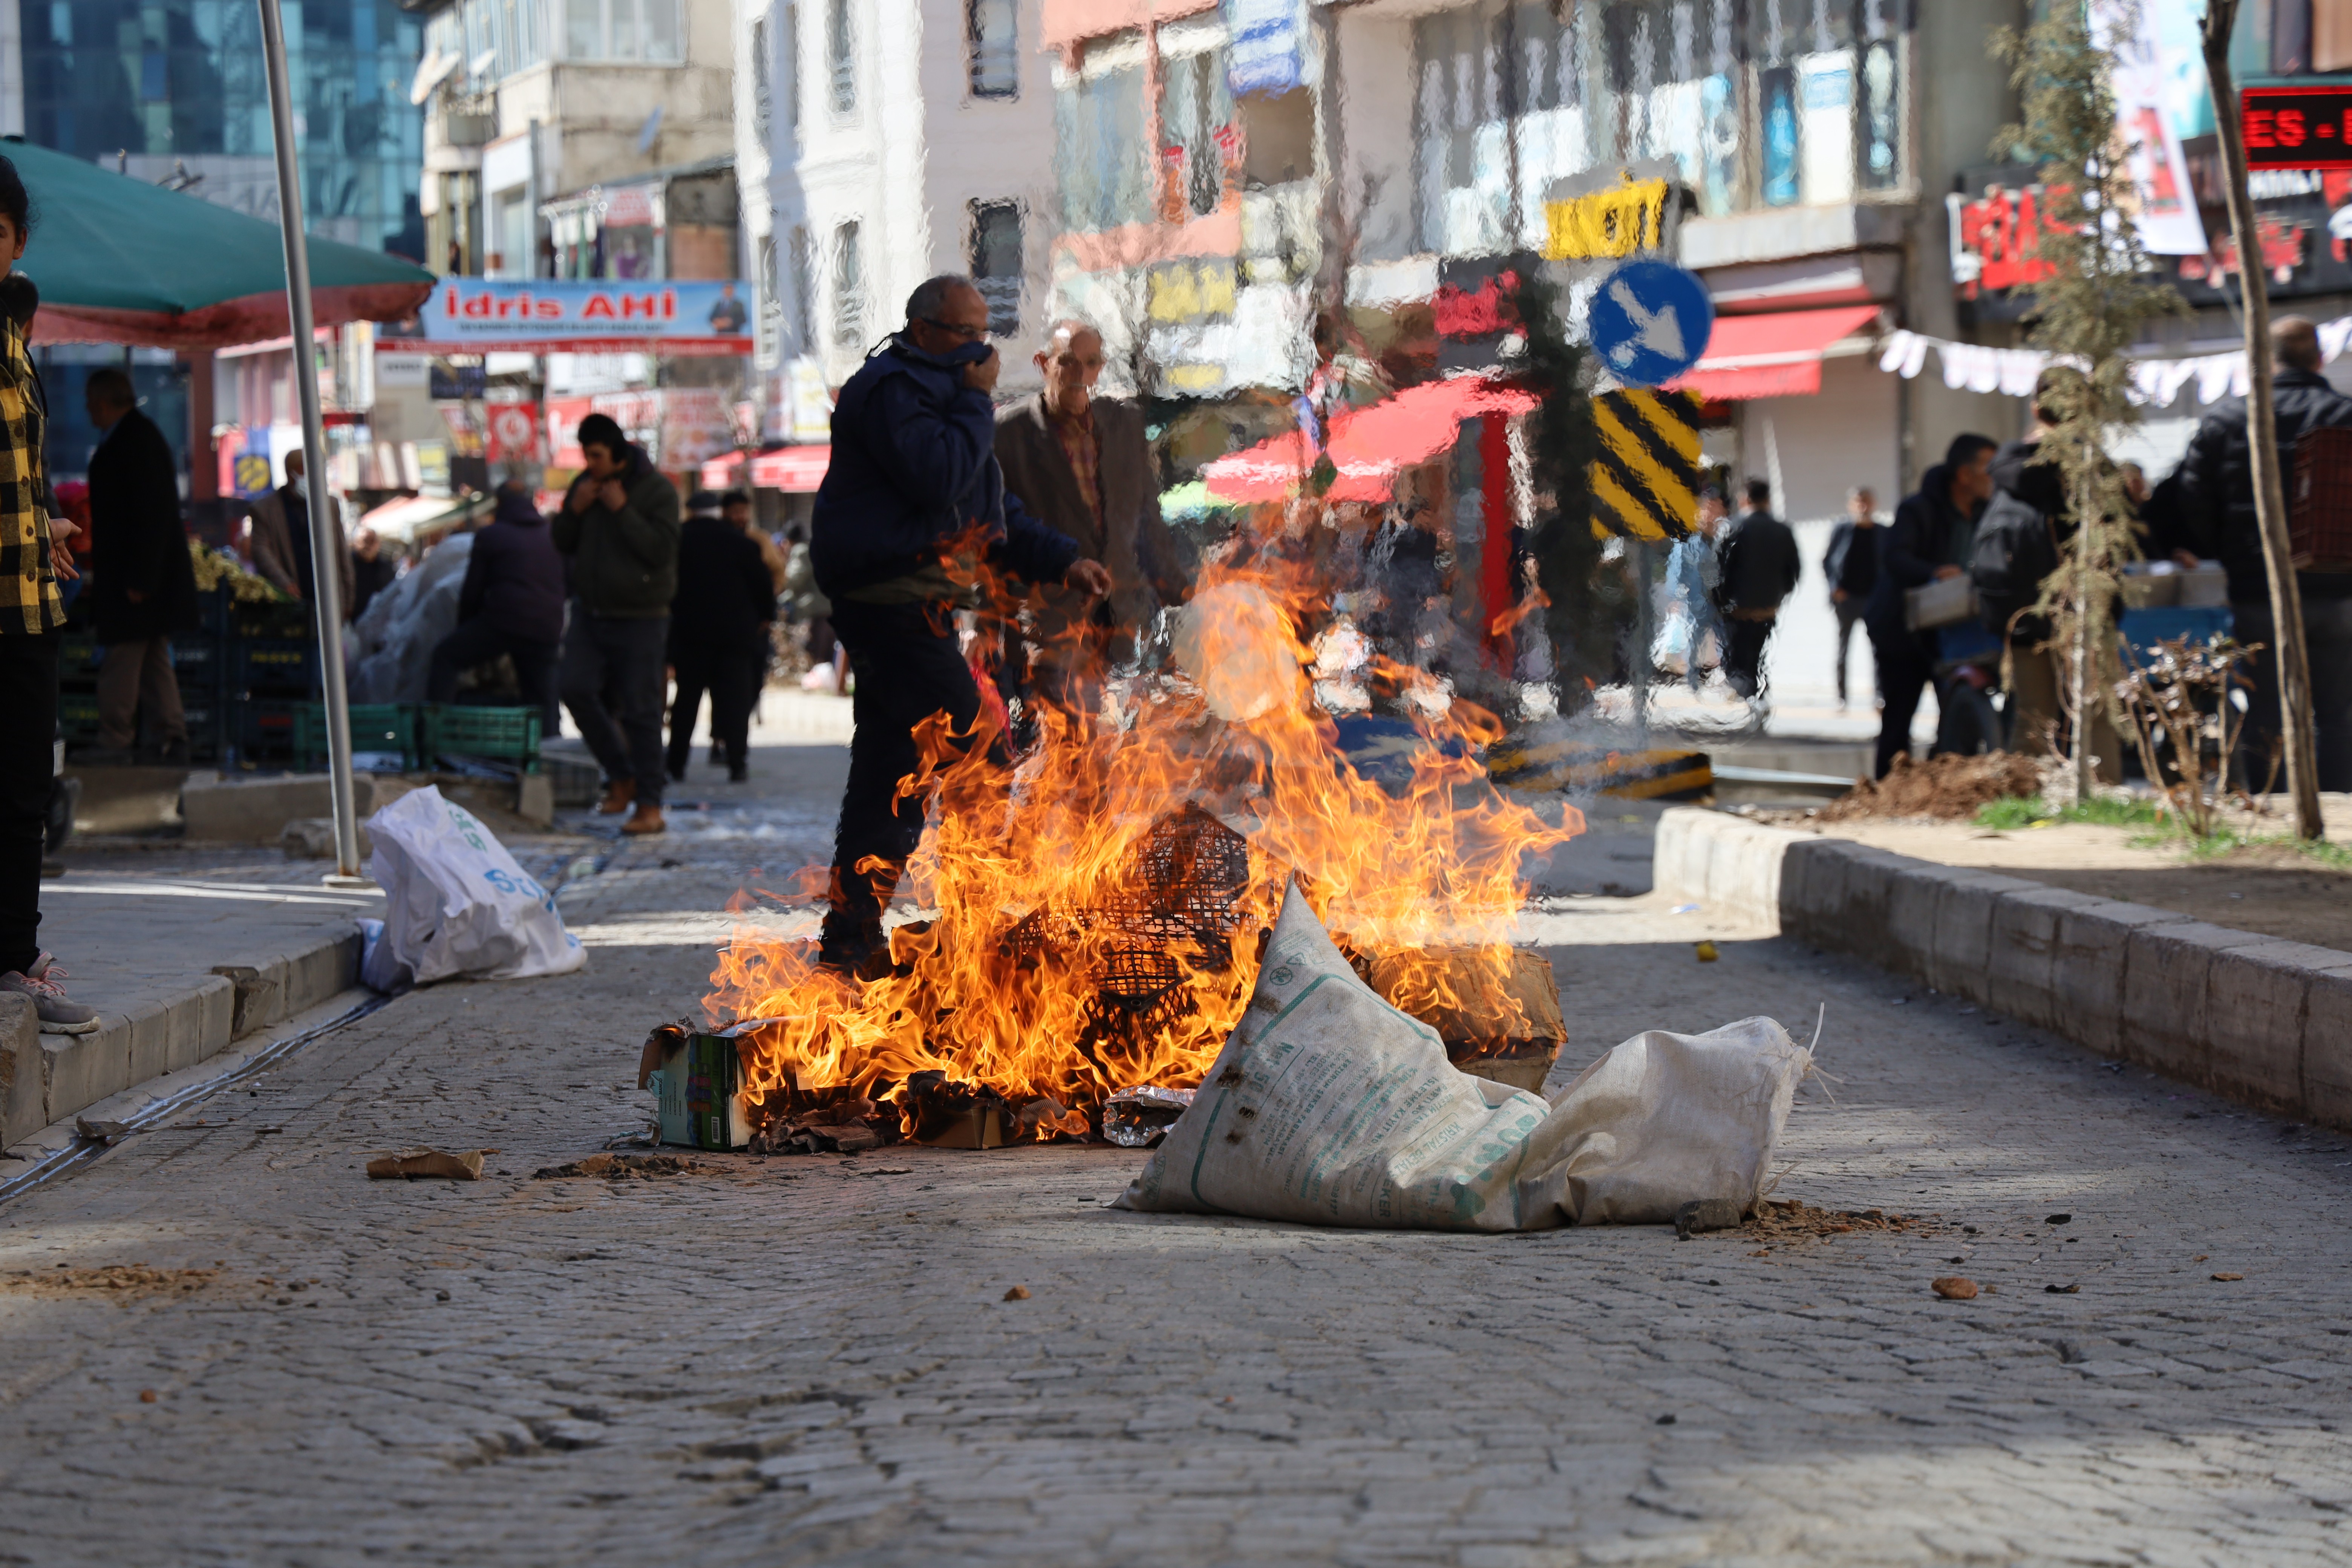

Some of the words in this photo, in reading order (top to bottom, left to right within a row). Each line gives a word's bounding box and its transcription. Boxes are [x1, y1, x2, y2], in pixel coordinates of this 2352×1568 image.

[445, 285, 564, 320] İdris
[582, 287, 678, 322] AHİ
[1248, 1072, 1271, 1095] 50
[1322, 1058, 1352, 1089] ERZURUM
[1320, 1092, 1348, 1125] ORTAMDA
[1382, 1107, 1406, 1132] KAYIT
[1262, 1108, 1289, 1146] ERZURUM
[1264, 1121, 1290, 1164] KARAYOLU
[1292, 1124, 1323, 1162] MUHAFAZA
[1422, 1121, 1464, 1154] KRİSTAL
[1393, 1148, 1427, 1176] BEYAZ
